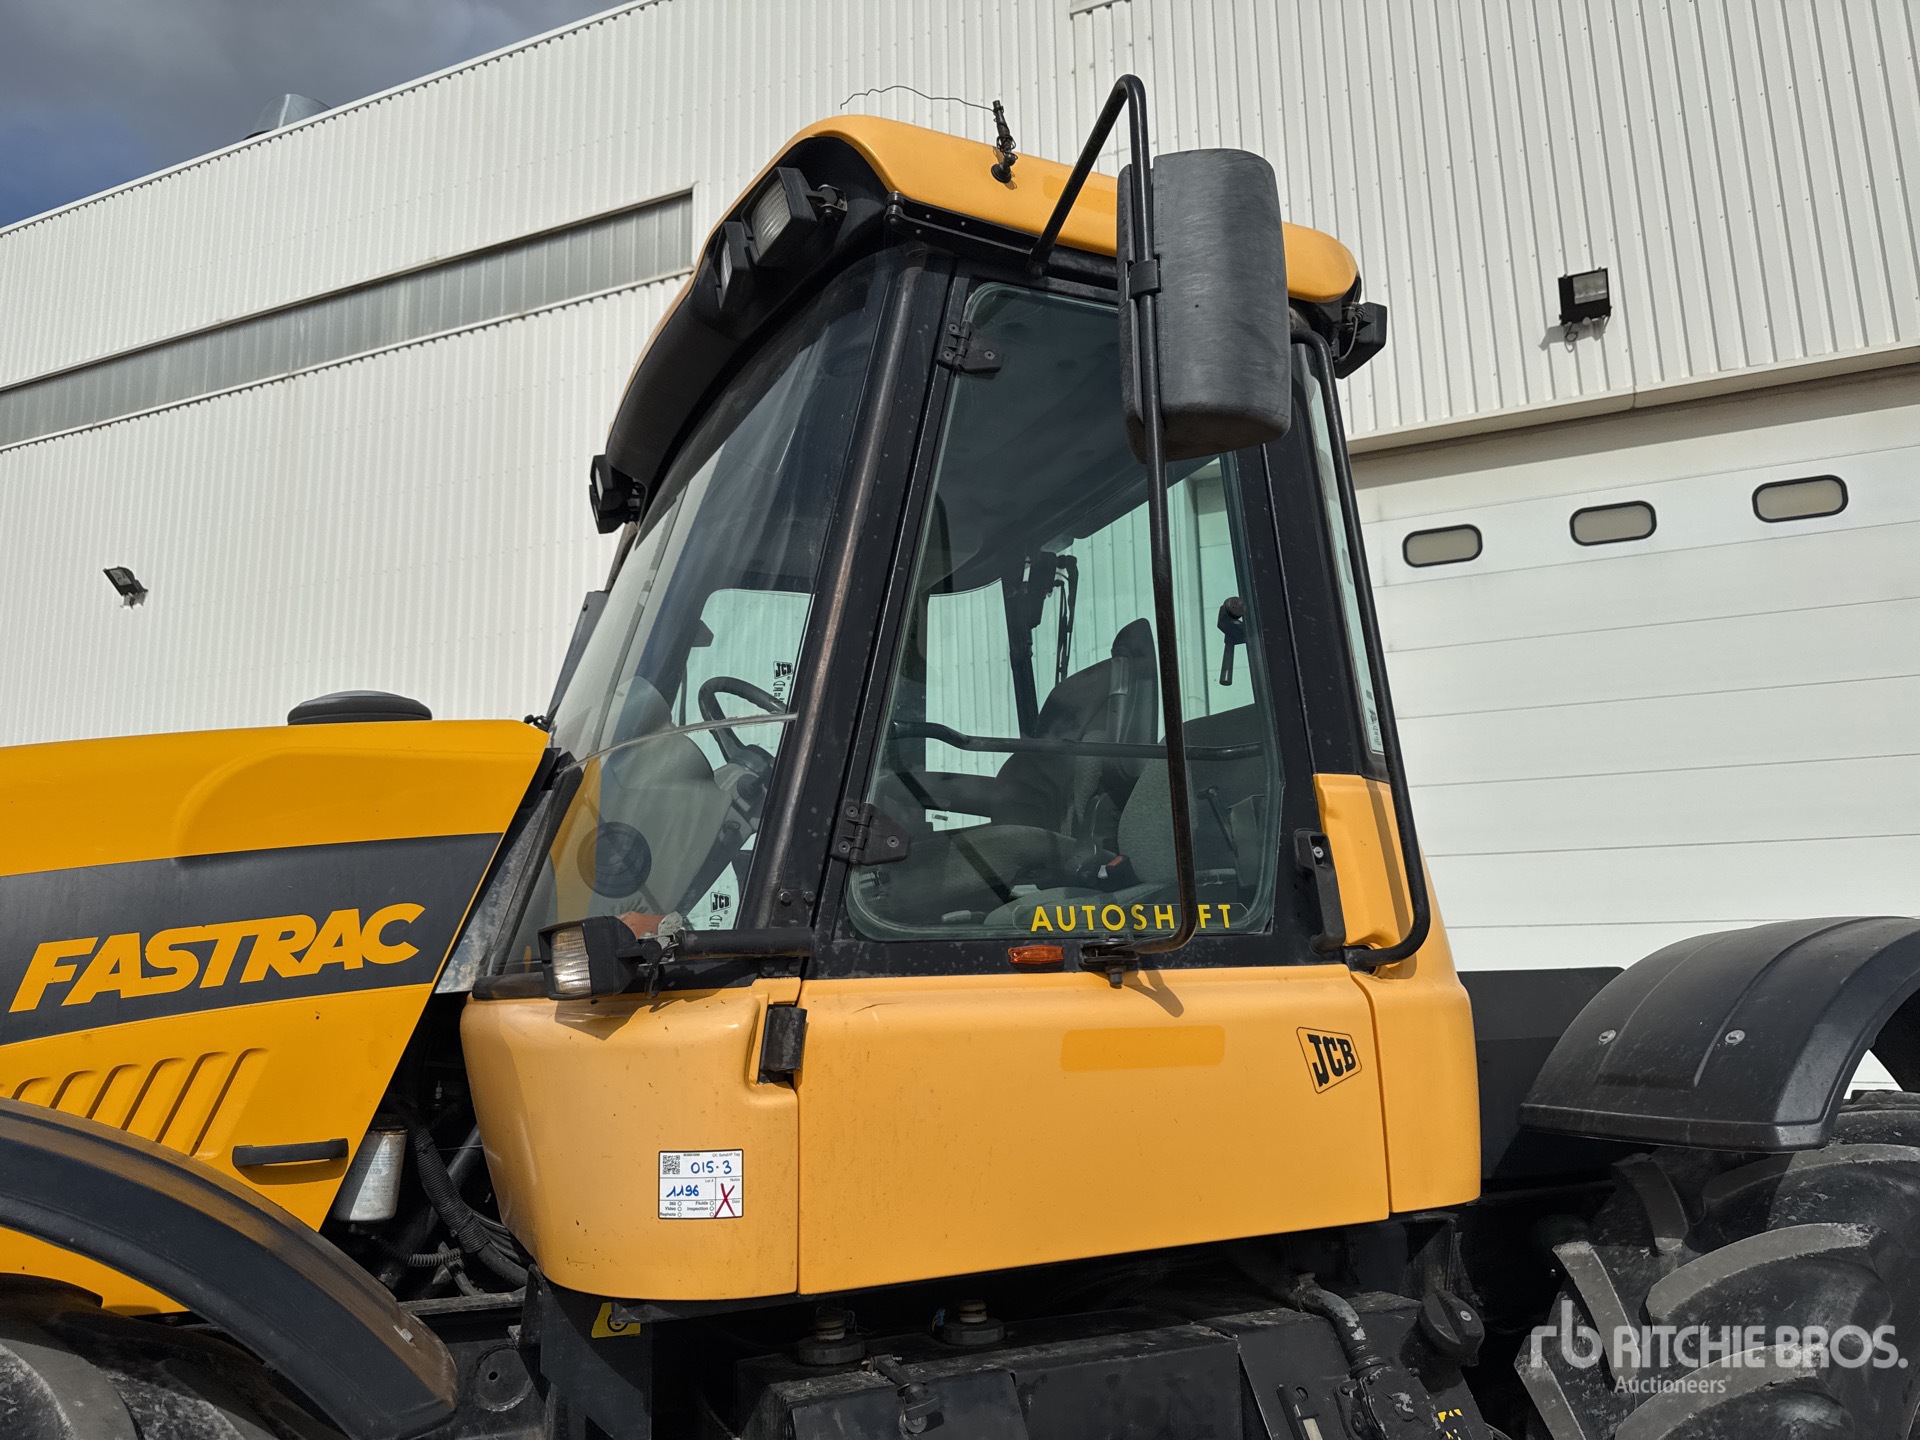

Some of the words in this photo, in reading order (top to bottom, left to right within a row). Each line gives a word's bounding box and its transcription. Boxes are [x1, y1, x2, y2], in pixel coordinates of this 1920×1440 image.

[775, 662, 792, 678] JCB
[712, 893, 730, 911] JCB
[1030, 903, 1232, 932] AUTOSHFT
[8, 902, 426, 1013] FASTRAC
[1306, 1033, 1357, 1088] JCB
